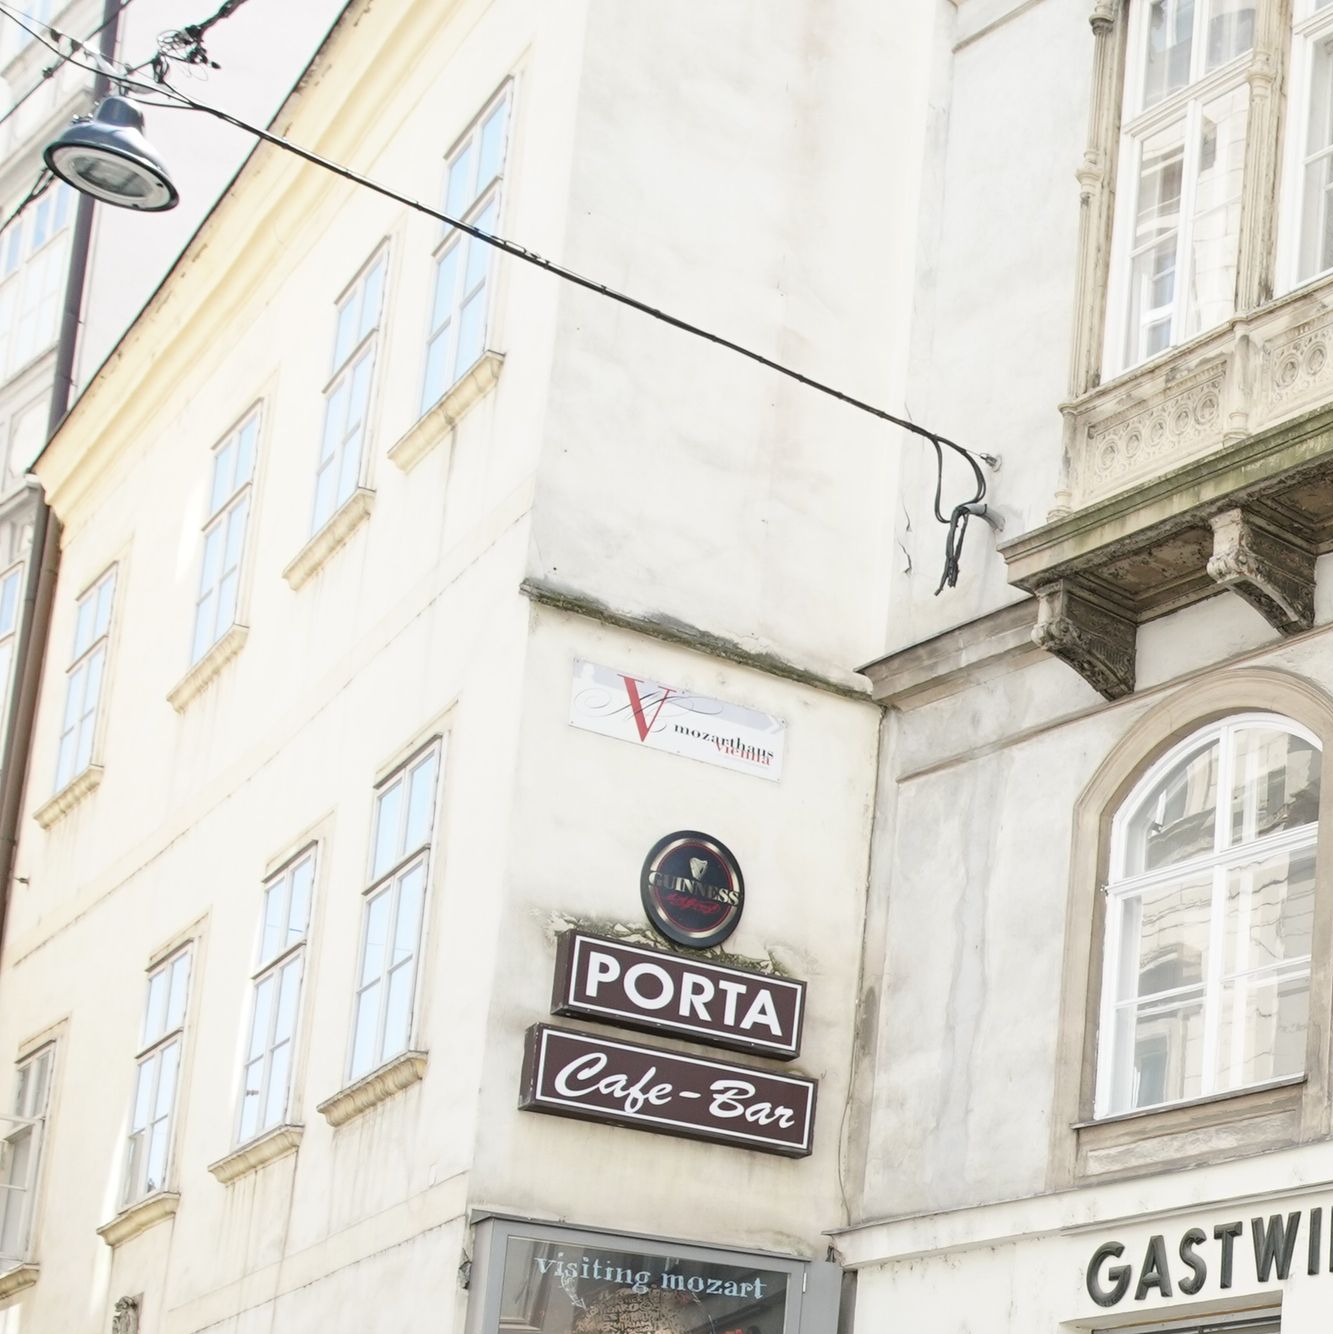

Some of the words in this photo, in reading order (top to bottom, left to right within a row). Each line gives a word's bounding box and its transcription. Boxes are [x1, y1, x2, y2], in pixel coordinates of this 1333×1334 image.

[674, 724, 774, 759] mozarthaus
[648, 871, 740, 907] GUINNESS
[585, 951, 782, 1037] PORTA
[534, 1252, 651, 1294] visiting
[661, 1270, 767, 1299] mozart
